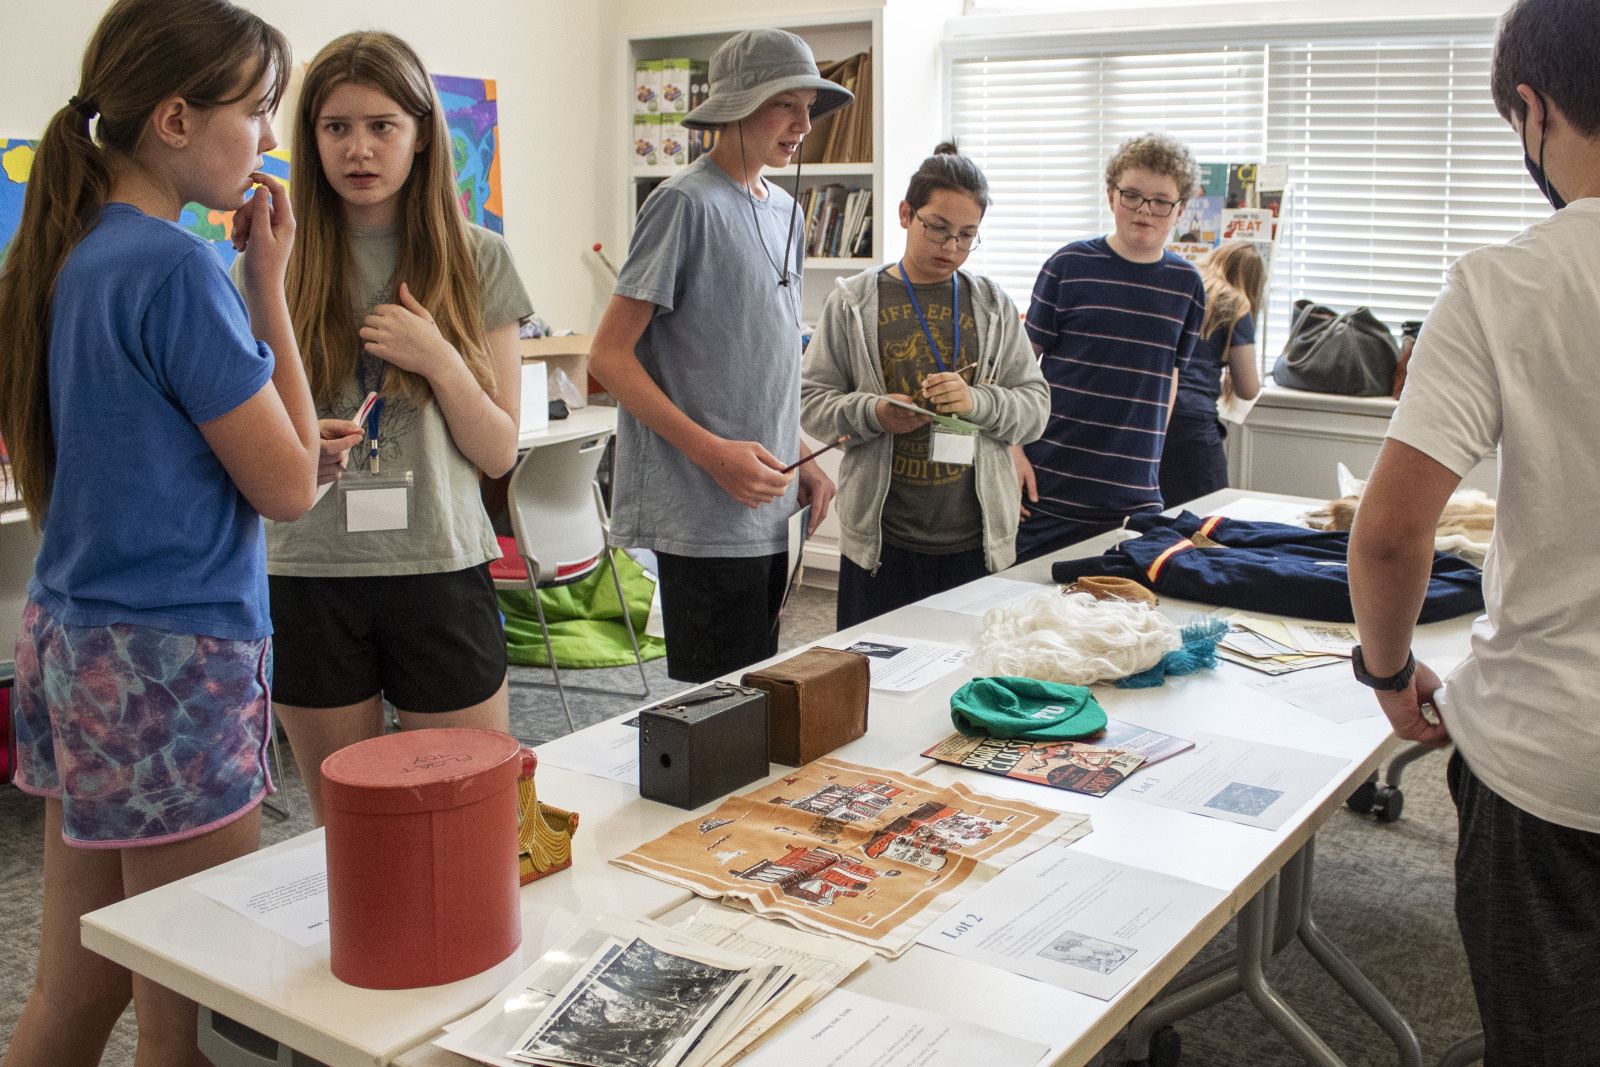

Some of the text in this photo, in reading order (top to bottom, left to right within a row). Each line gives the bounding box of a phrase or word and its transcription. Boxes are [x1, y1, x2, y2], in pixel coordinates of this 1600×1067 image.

[961, 746, 1004, 770] SUGAR
[986, 740, 1035, 771] CLASSI
[1130, 782, 1152, 794] Lot
[940, 914, 984, 940] Lot 2
